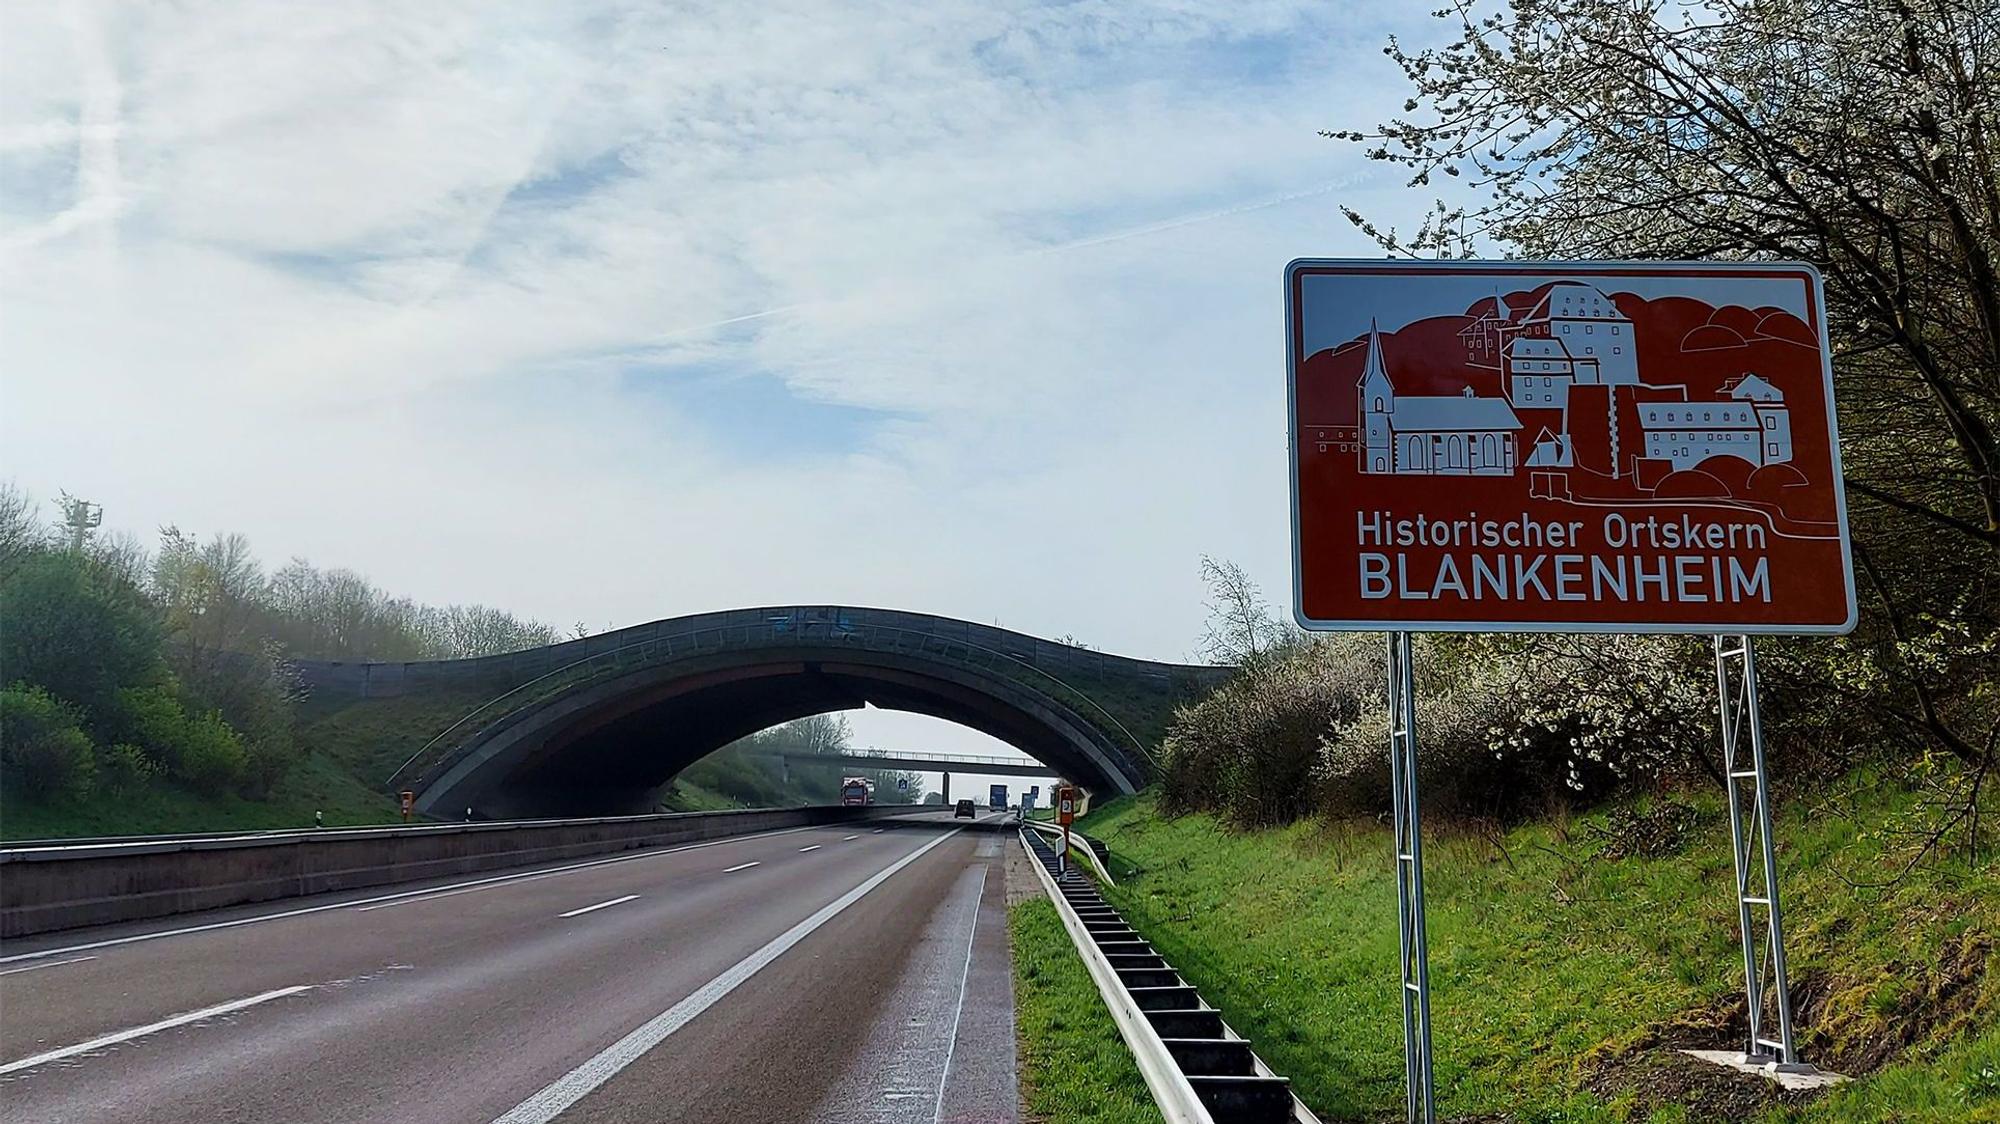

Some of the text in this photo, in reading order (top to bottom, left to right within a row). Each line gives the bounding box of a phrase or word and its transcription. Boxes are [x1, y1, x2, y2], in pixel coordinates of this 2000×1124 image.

[1357, 510, 1767, 549] Historischer Ortskern
[1359, 552, 1772, 603] BLANKENHEIM
